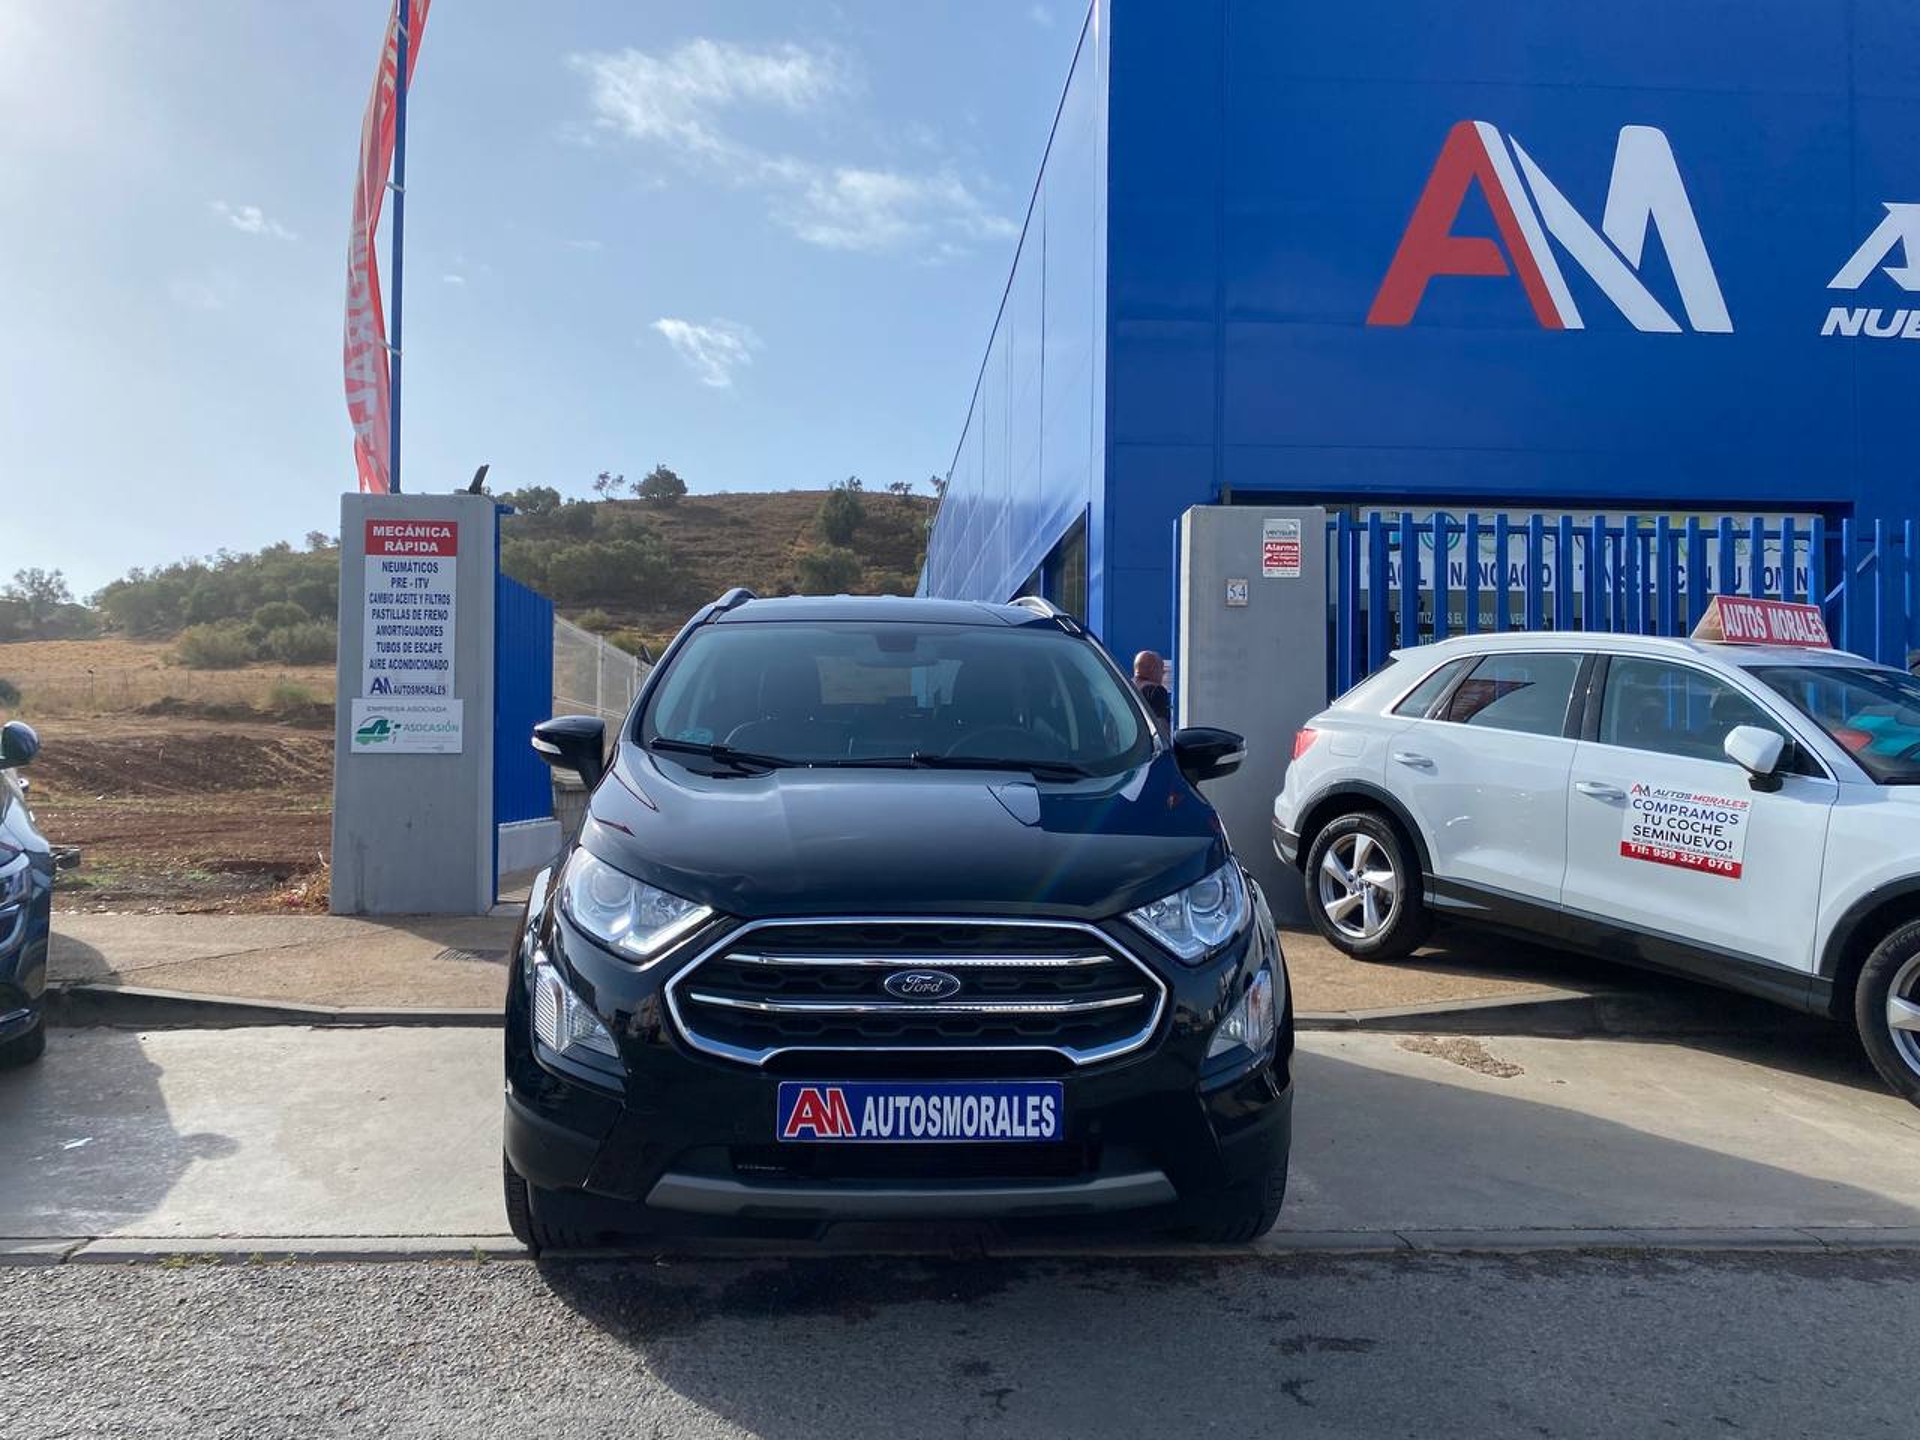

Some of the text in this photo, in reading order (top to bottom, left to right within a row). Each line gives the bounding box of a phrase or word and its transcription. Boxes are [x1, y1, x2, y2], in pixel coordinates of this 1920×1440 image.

[1366, 120, 1734, 334] AM
[372, 524, 451, 538] MECÁNICA
[384, 539, 439, 553] RÁPIDA
[391, 577, 408, 589] PRE
[414, 577, 430, 589] ITV
[395, 593, 418, 605] ACEITE
[424, 593, 451, 605] FILTROS
[371, 608, 449, 621] PASTILLAS DE FRENO
[1722, 602, 1829, 643] AUTOS MORALES
[376, 625, 444, 637] AMORTIGUADORES
[376, 642, 443, 653] TUBOS DE ESCAPE
[369, 659, 449, 670] AIRE ACONDICIONADO
[393, 685, 446, 695] AUTOSMORALES
[1653, 788, 1692, 799] AUTOS
[1692, 794, 1749, 807] MORALES
[1632, 799, 1739, 825] COMPRAMOS
[1643, 813, 1723, 836] TU COCHE
[1632, 825, 1732, 852] SEMINUEVO!
[1652, 848, 1677, 859] 959
[1680, 853, 1704, 865] 327
[1707, 858, 1733, 871] 076
[901, 974, 943, 992] Ford
[784, 1088, 1056, 1138] AM AUTOSMORALES
